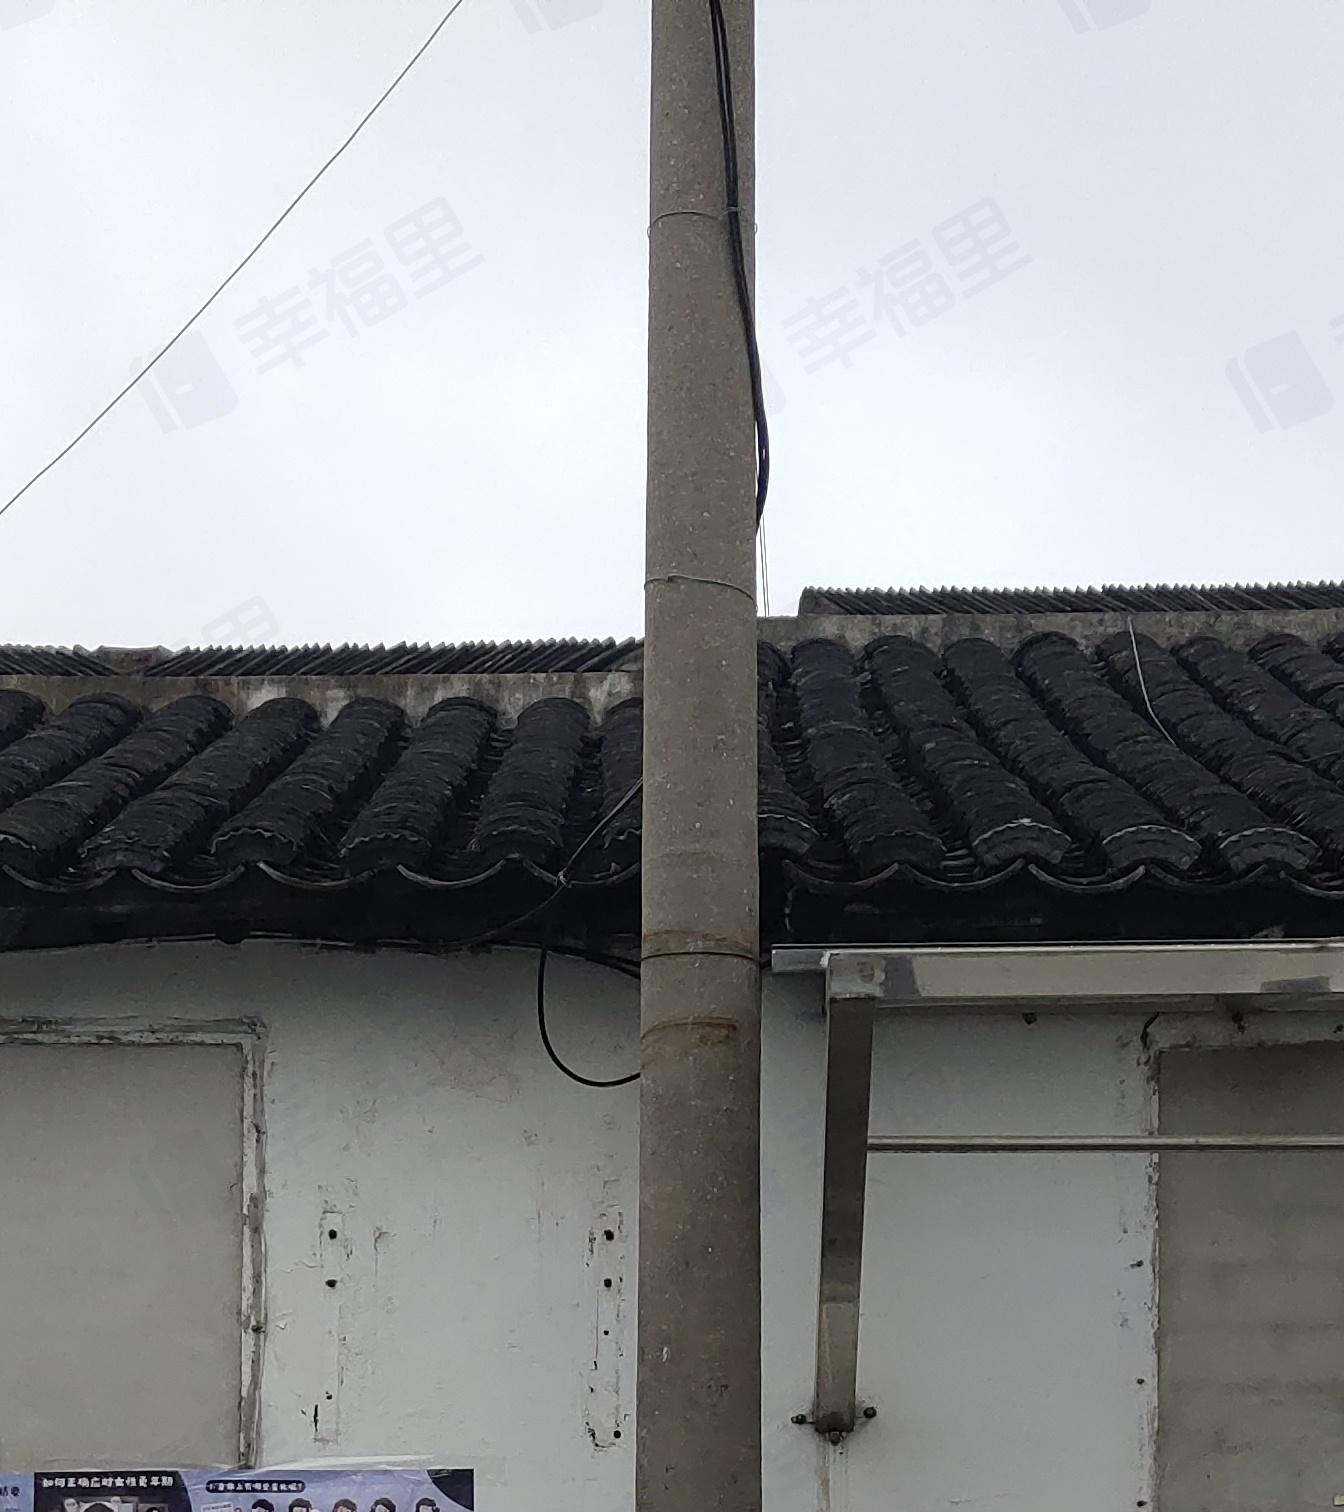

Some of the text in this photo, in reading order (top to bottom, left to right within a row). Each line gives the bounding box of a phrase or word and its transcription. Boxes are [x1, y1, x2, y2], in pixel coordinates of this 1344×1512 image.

[42, 1475, 174, 1488] 如何正确应对女性更年期
